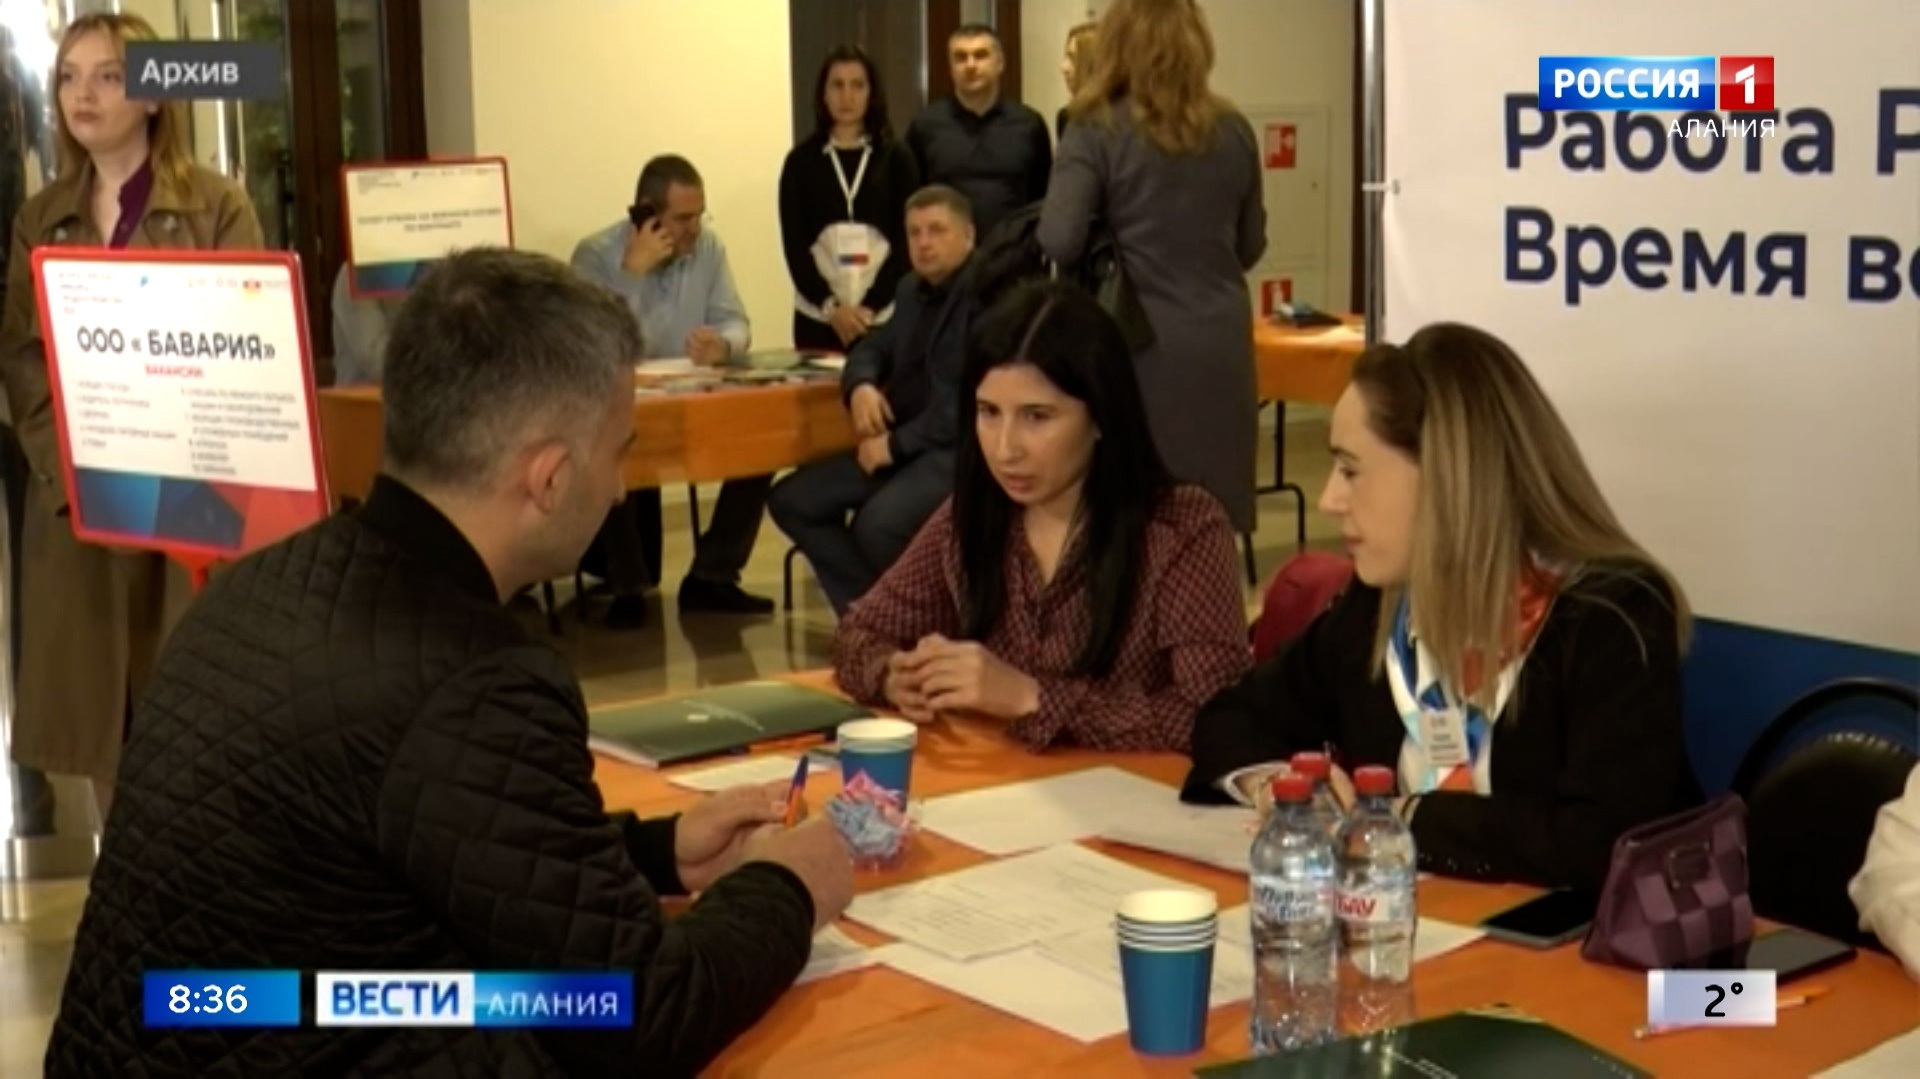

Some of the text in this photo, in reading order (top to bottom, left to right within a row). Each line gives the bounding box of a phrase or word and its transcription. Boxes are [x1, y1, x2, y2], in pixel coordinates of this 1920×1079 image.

[1504, 93, 1836, 174] Работа
[1504, 206, 1920, 306] Время в
[77, 325, 125, 354] ООО
[147, 329, 276, 360] БАВАРИЯ»
